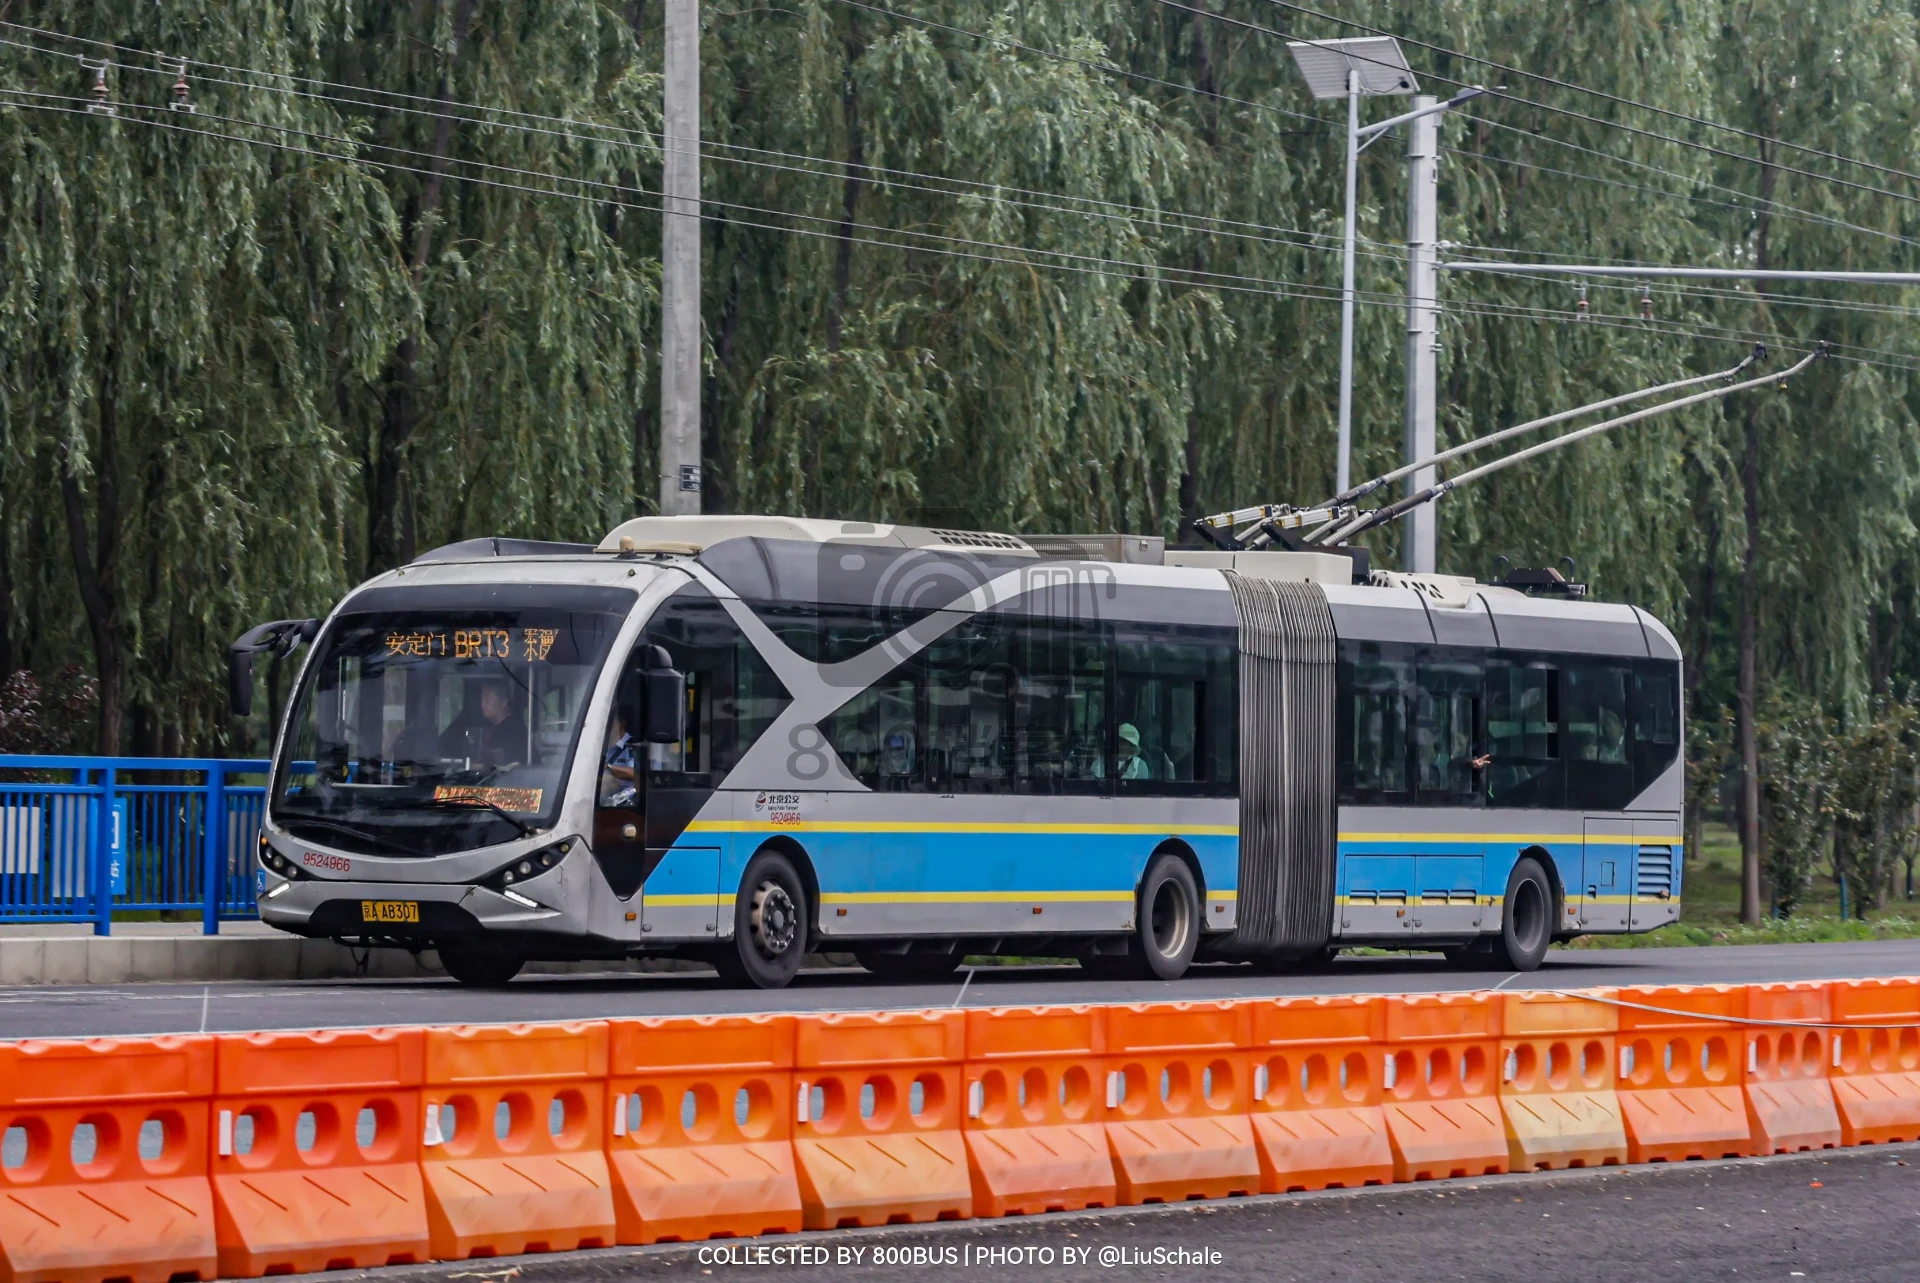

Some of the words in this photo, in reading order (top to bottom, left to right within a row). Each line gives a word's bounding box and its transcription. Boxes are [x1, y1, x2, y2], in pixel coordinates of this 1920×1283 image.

[385, 631, 446, 657] 安定门
[454, 630, 510, 658] BRT3
[768, 794, 800, 804] 北京公交
[770, 812, 801, 826] 9524966
[302, 852, 351, 872] 9524966
